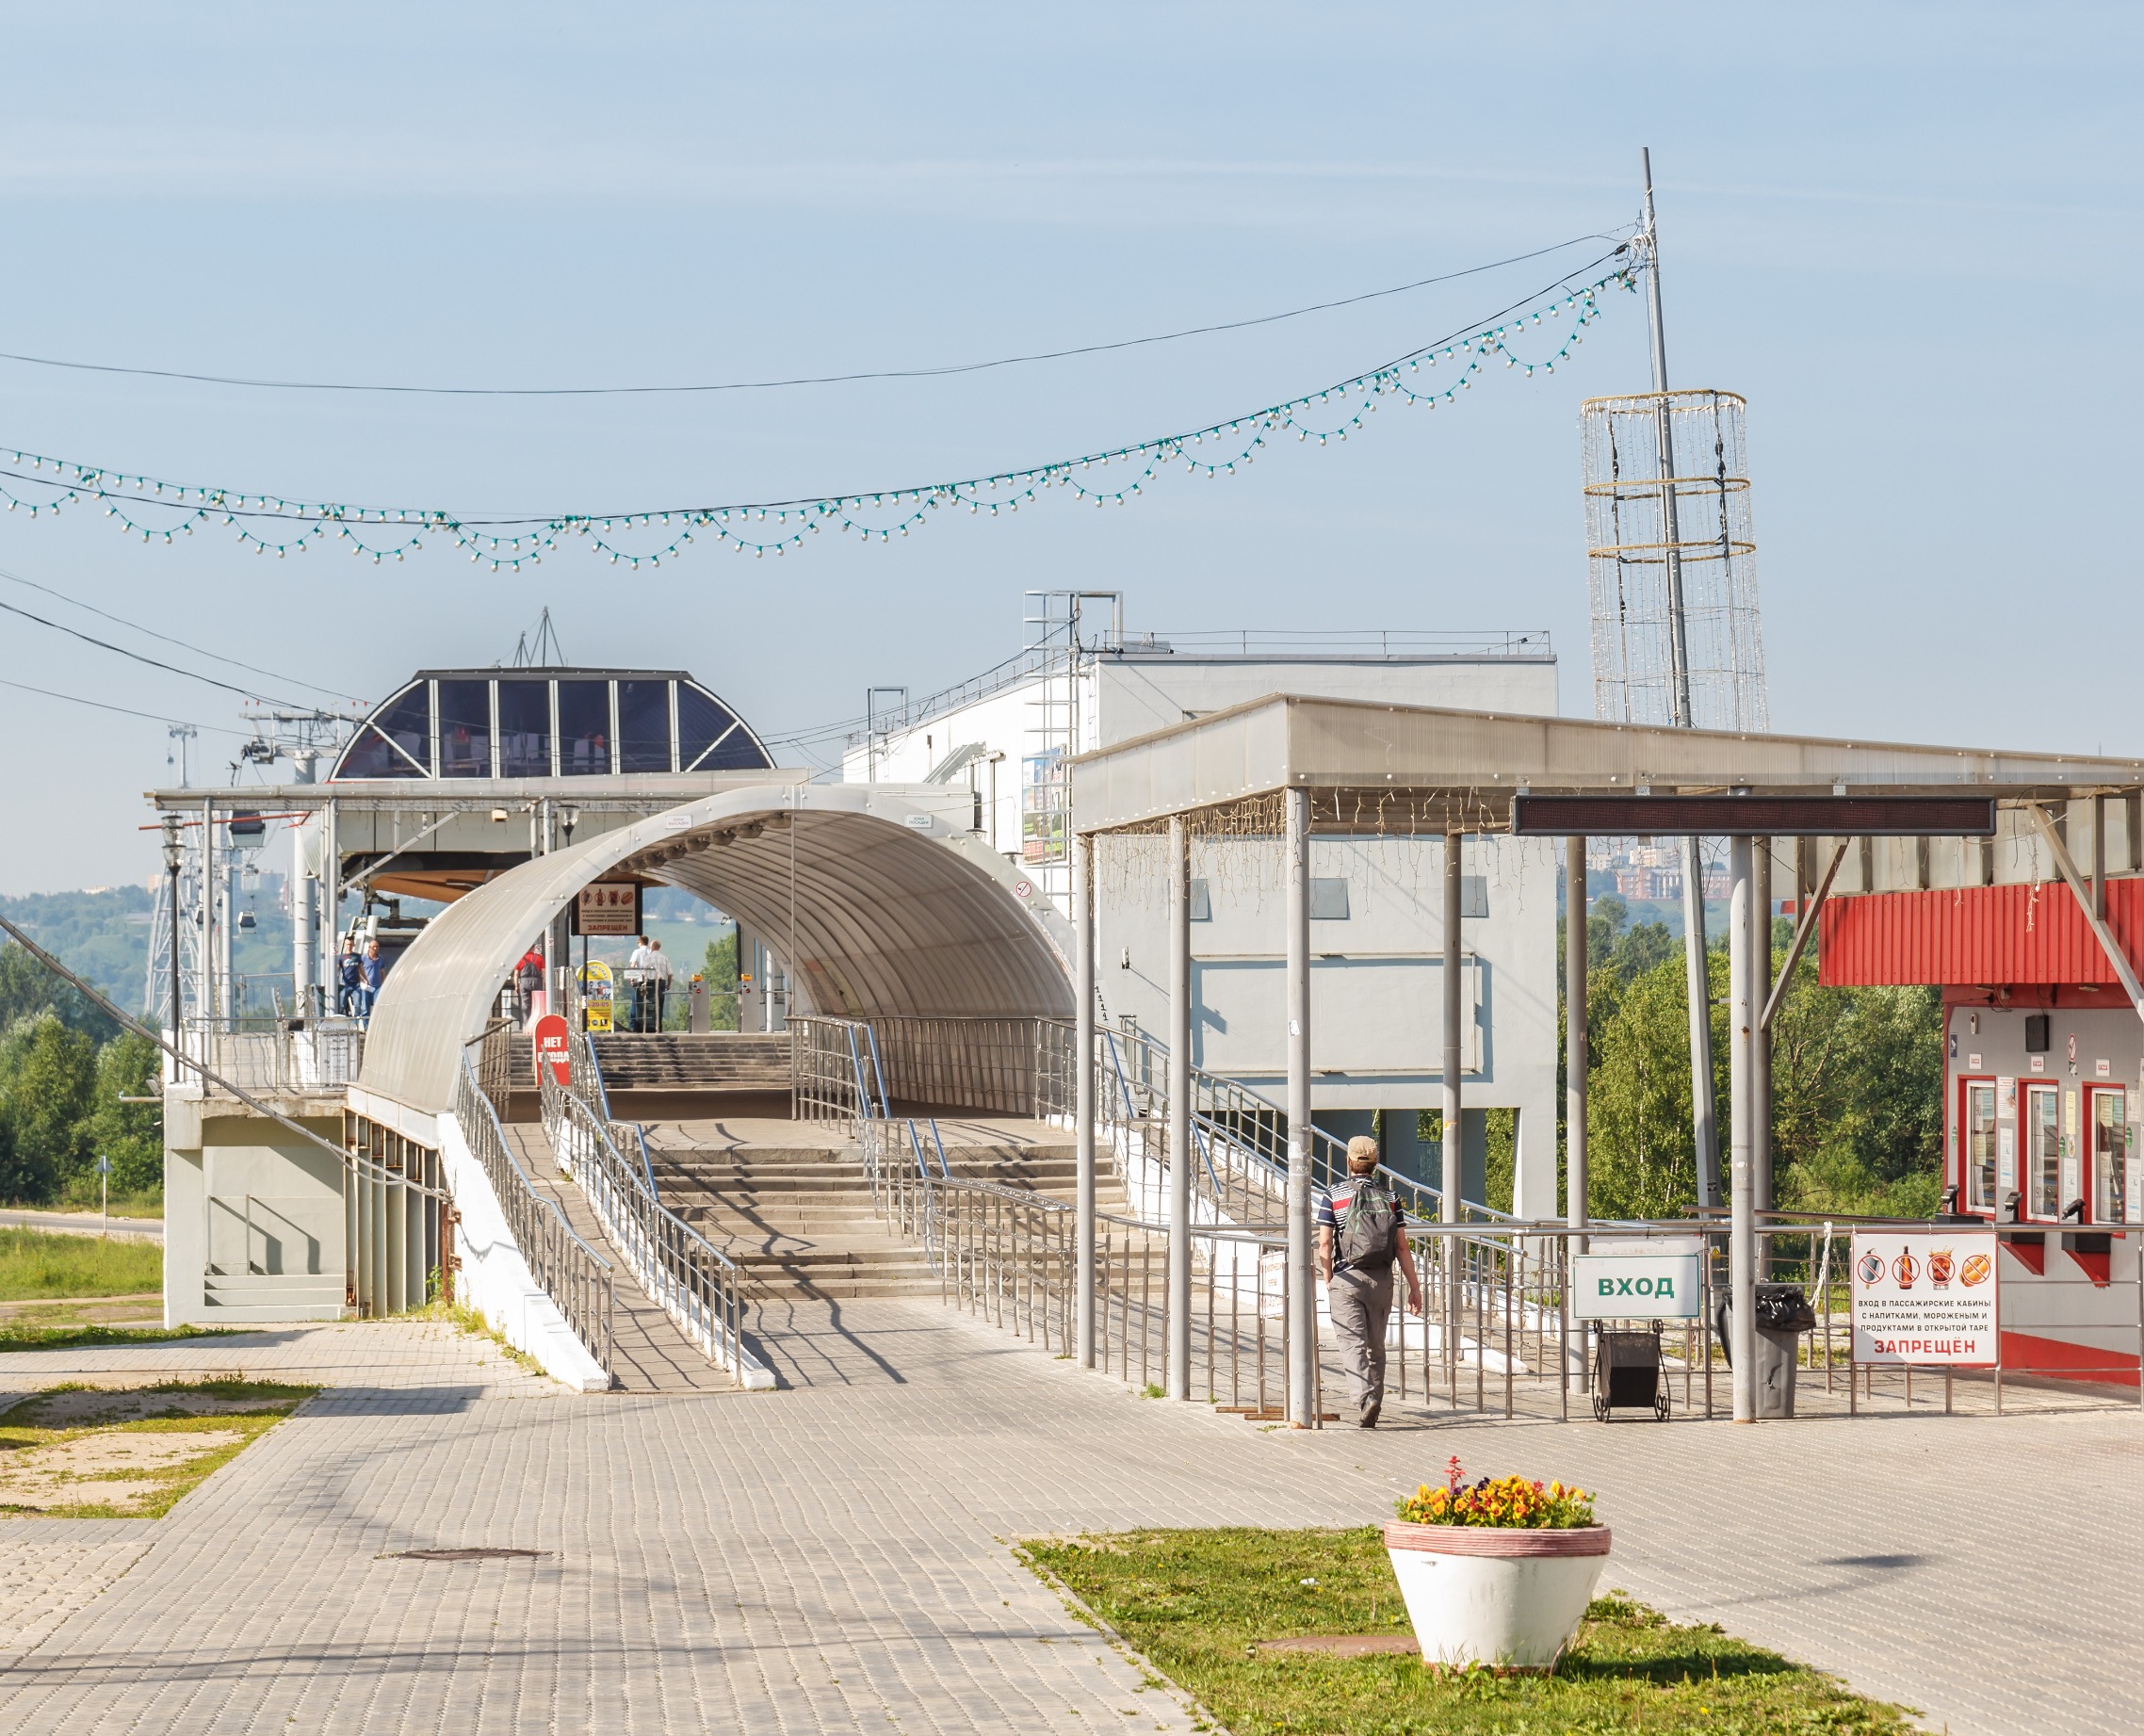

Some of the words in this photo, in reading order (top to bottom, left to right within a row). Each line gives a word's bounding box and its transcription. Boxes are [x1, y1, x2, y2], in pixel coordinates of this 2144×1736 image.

[544, 1037, 562, 1047] НЕТ
[1599, 1278, 1675, 1299] ВХОД
[1875, 1337, 1975, 1355] ЗАПРЕЩЁН
